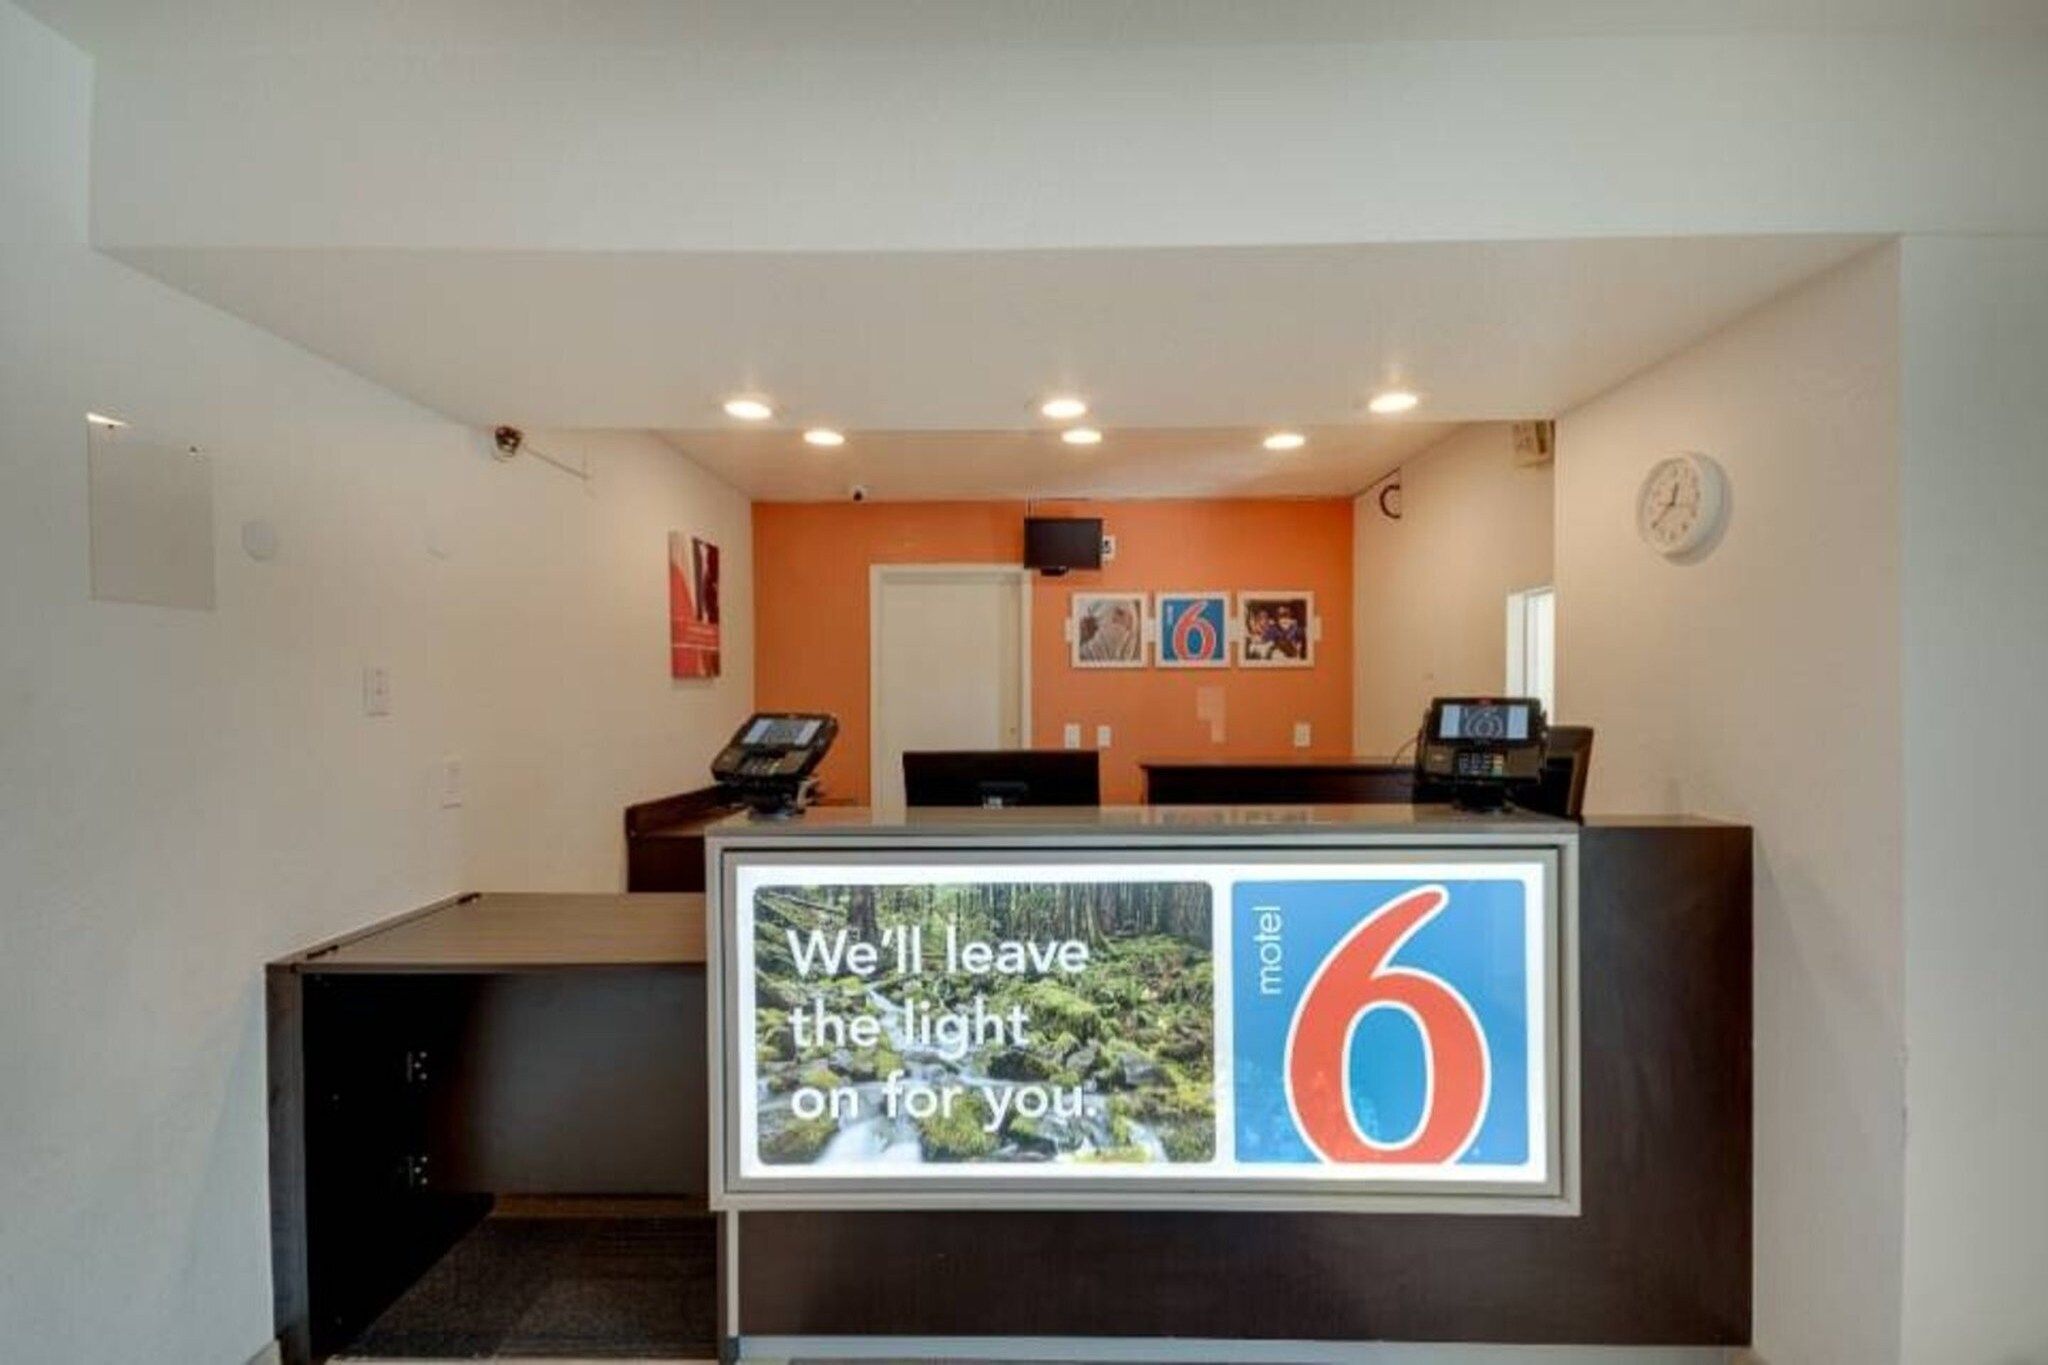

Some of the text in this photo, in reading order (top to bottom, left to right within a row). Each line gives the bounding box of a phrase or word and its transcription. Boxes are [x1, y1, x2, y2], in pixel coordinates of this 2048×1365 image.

[1172, 600, 1217, 661] 6
[786, 924, 1090, 975] We'll leave
[1252, 905, 1282, 996] motel
[788, 997, 1030, 1060] the light
[1283, 884, 1492, 1164] 6
[791, 1069, 1098, 1133] on for you.
